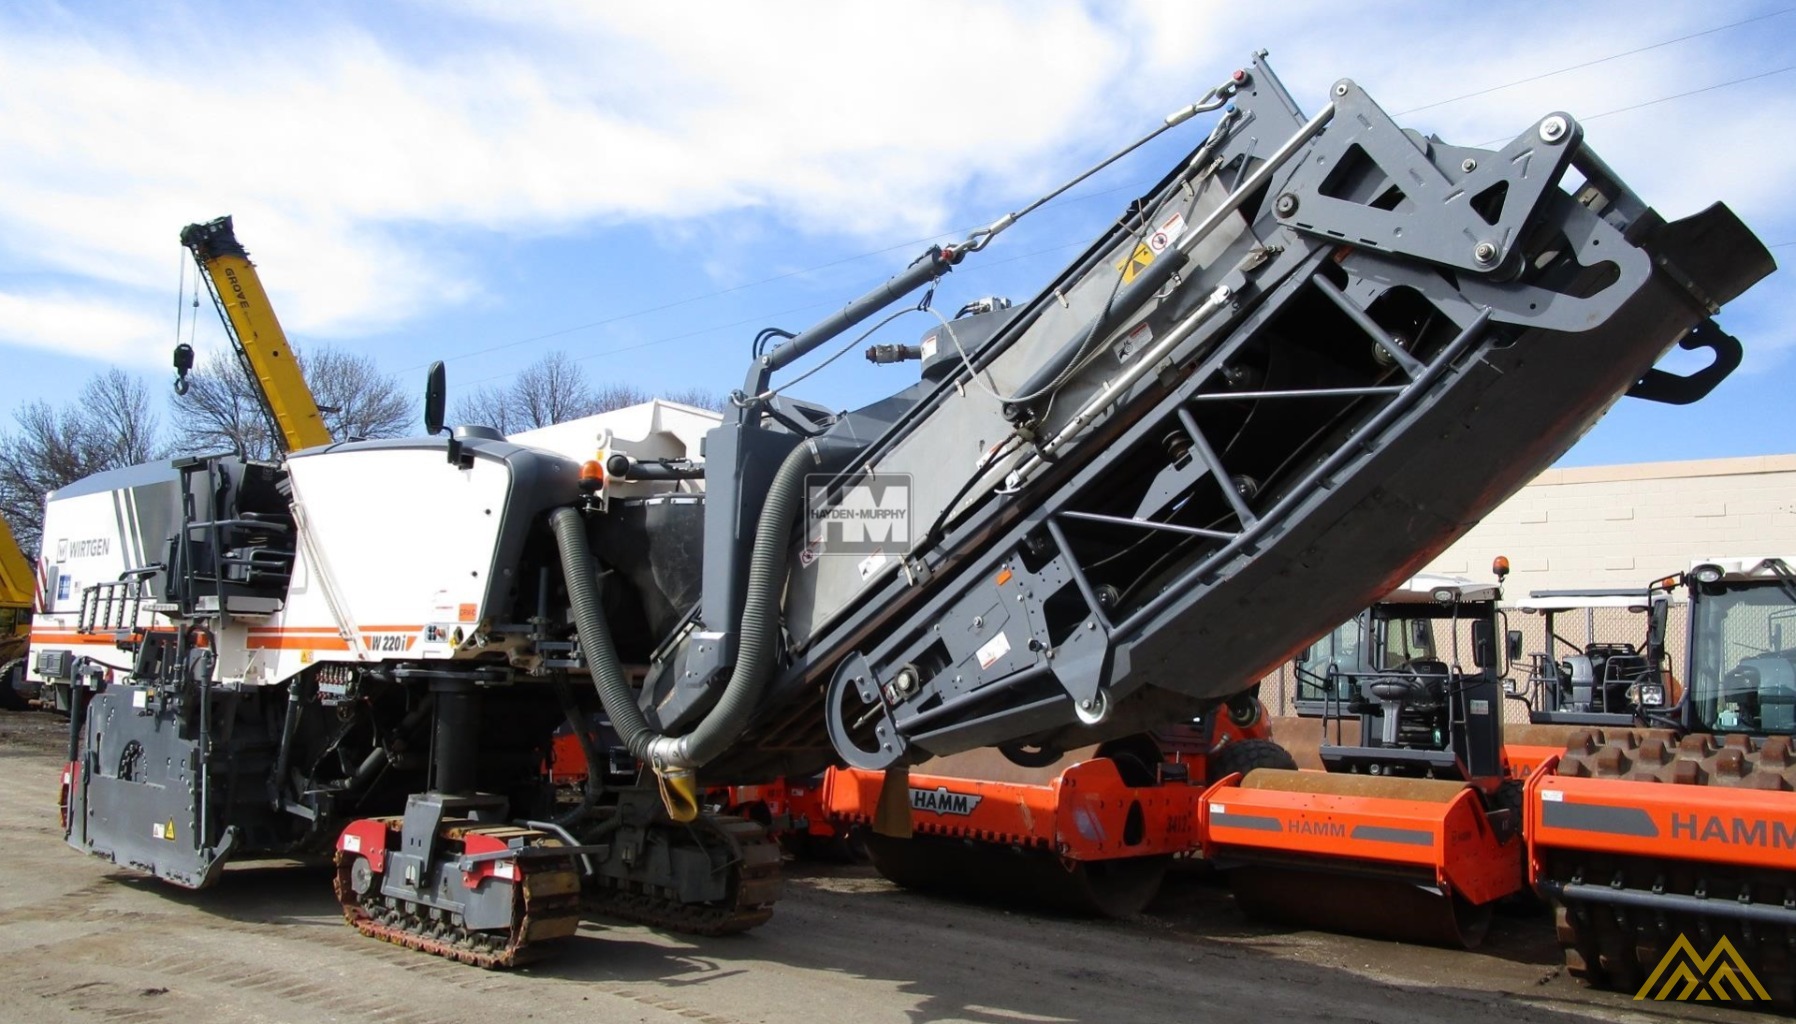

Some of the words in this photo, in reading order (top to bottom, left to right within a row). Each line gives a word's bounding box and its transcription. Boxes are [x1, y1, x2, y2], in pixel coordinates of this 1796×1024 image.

[225, 268, 250, 309] GROVE
[69, 538, 110, 558] WIRTGEN
[372, 636, 382, 651] W
[914, 791, 967, 813] HAMM
[1289, 819, 1345, 838] HAMM
[1671, 811, 1796, 850] HAMM
